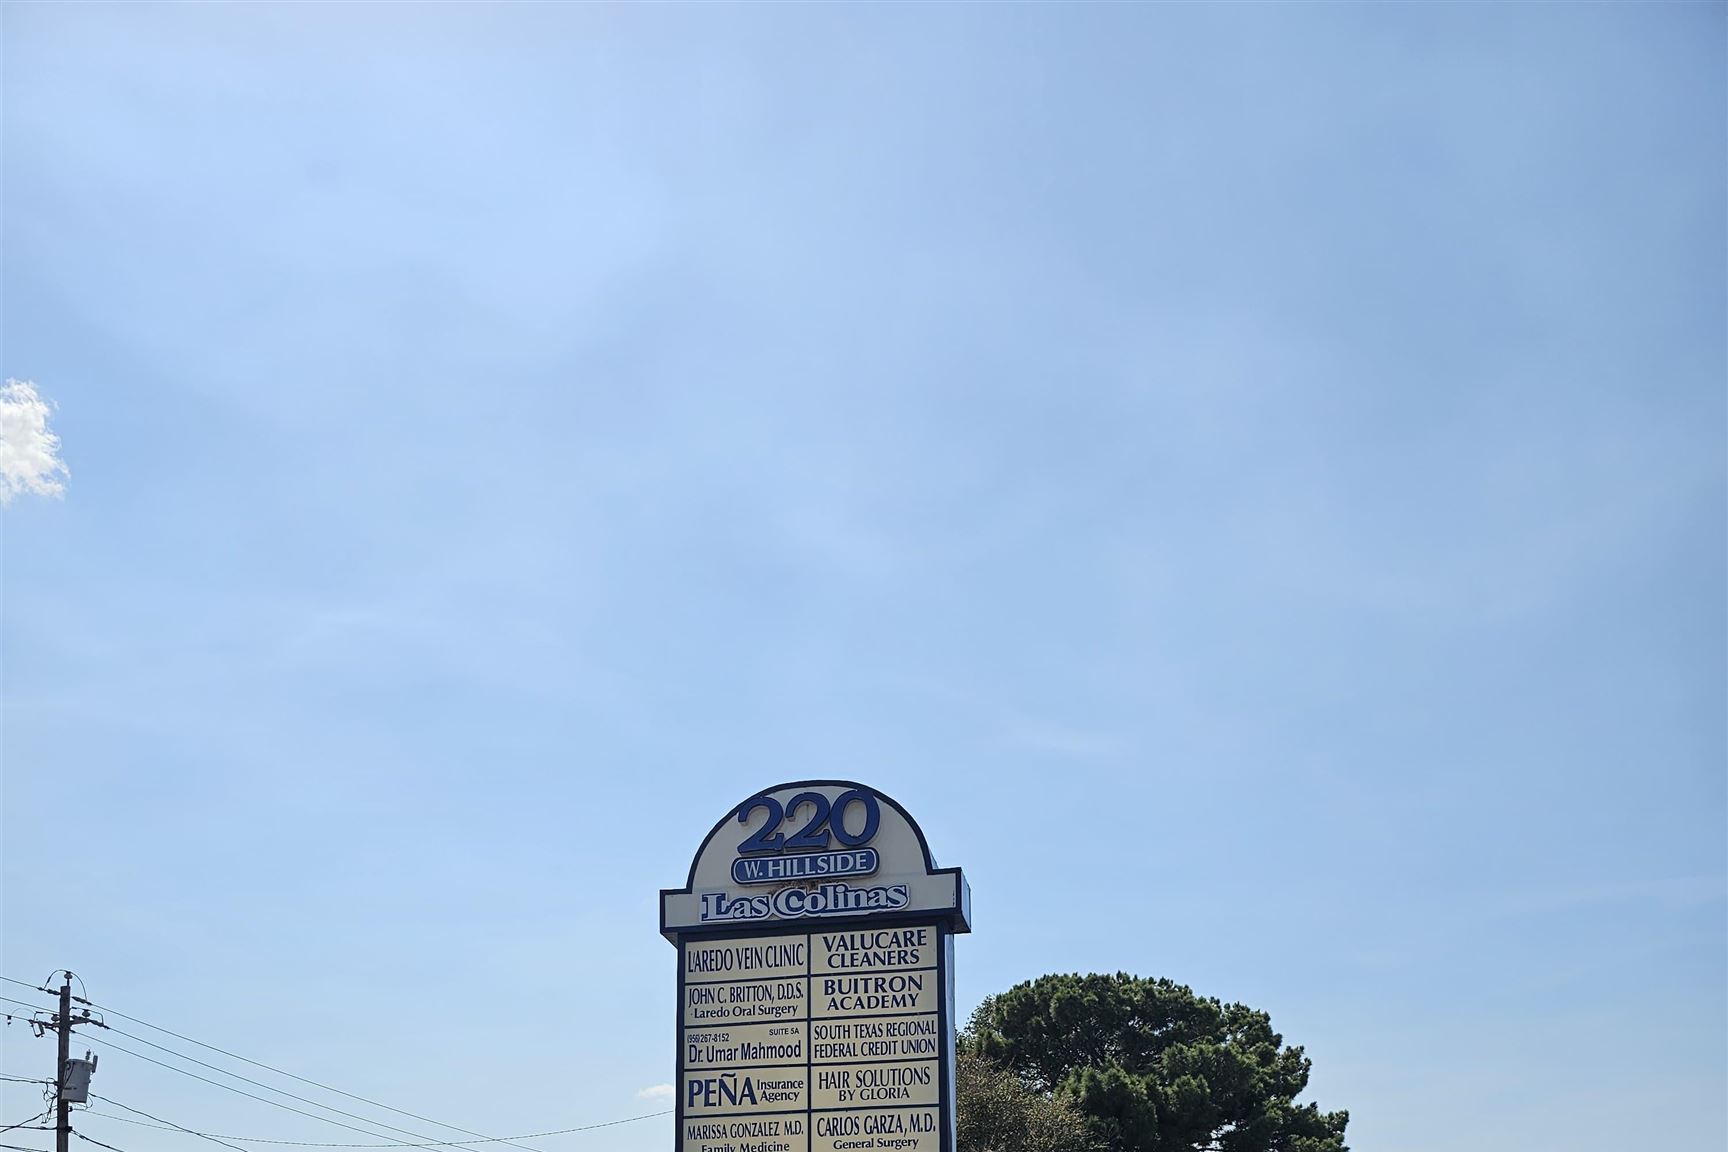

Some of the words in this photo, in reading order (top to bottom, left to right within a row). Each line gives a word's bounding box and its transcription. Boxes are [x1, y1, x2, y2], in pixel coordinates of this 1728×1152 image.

[737, 789, 880, 854] 220
[744, 860, 763, 877] W.
[768, 853, 868, 876] HILLSIDE
[702, 892, 768, 921] Las
[773, 884, 909, 918] Colinas
[822, 929, 927, 952] VALUCARE
[736, 946, 763, 970] VEIN
[765, 943, 804, 968] CLINIC
[827, 948, 920, 968] CLEANERS
[688, 987, 715, 1008] JOHN
[717, 986, 727, 1003] C.
[729, 983, 774, 1004] BRITTON,
[777, 981, 804, 1000] D.D.S.
[824, 974, 923, 996] BUITRON
[694, 1006, 730, 1018] Laredo
[732, 1004, 756, 1017] Oral
[757, 1004, 798, 1018] Surgery
[827, 993, 919, 1011] ACADEMY
[769, 1028, 789, 1036] SUITE
[790, 1027, 800, 1035] 5A
[814, 1024, 851, 1040] SOUTH
[853, 1022, 883, 1038] TEXAS
[886, 1020, 936, 1037] REGIONAL
[689, 1044, 704, 1063] Dr.
[706, 1045, 738, 1063] Umar
[741, 1040, 801, 1061] Mahmood
[814, 1042, 858, 1058] FEDERAL
[861, 1040, 898, 1056] CREDIT
[901, 1038, 936, 1054] UNION
[757, 1079, 804, 1090] Insurance
[818, 1070, 850, 1089] HAIR
[855, 1066, 930, 1088] SOLUTIONS
[688, 1073, 758, 1108] PEÑA
[760, 1090, 800, 1103] Agency
[839, 1089, 856, 1101] BY
[860, 1087, 910, 1100] GLORIA
[687, 1124, 728, 1140] MARISSA
[730, 1121, 780, 1138] GONZALEZ
[784, 1120, 804, 1136] M.D.
[817, 1115, 860, 1137] CARLOS
[863, 1114, 907, 1137] GARZA,
[909, 1113, 936, 1133] M.D.
[833, 1138, 874, 1149] General
[877, 1137, 919, 1150] Surgery
